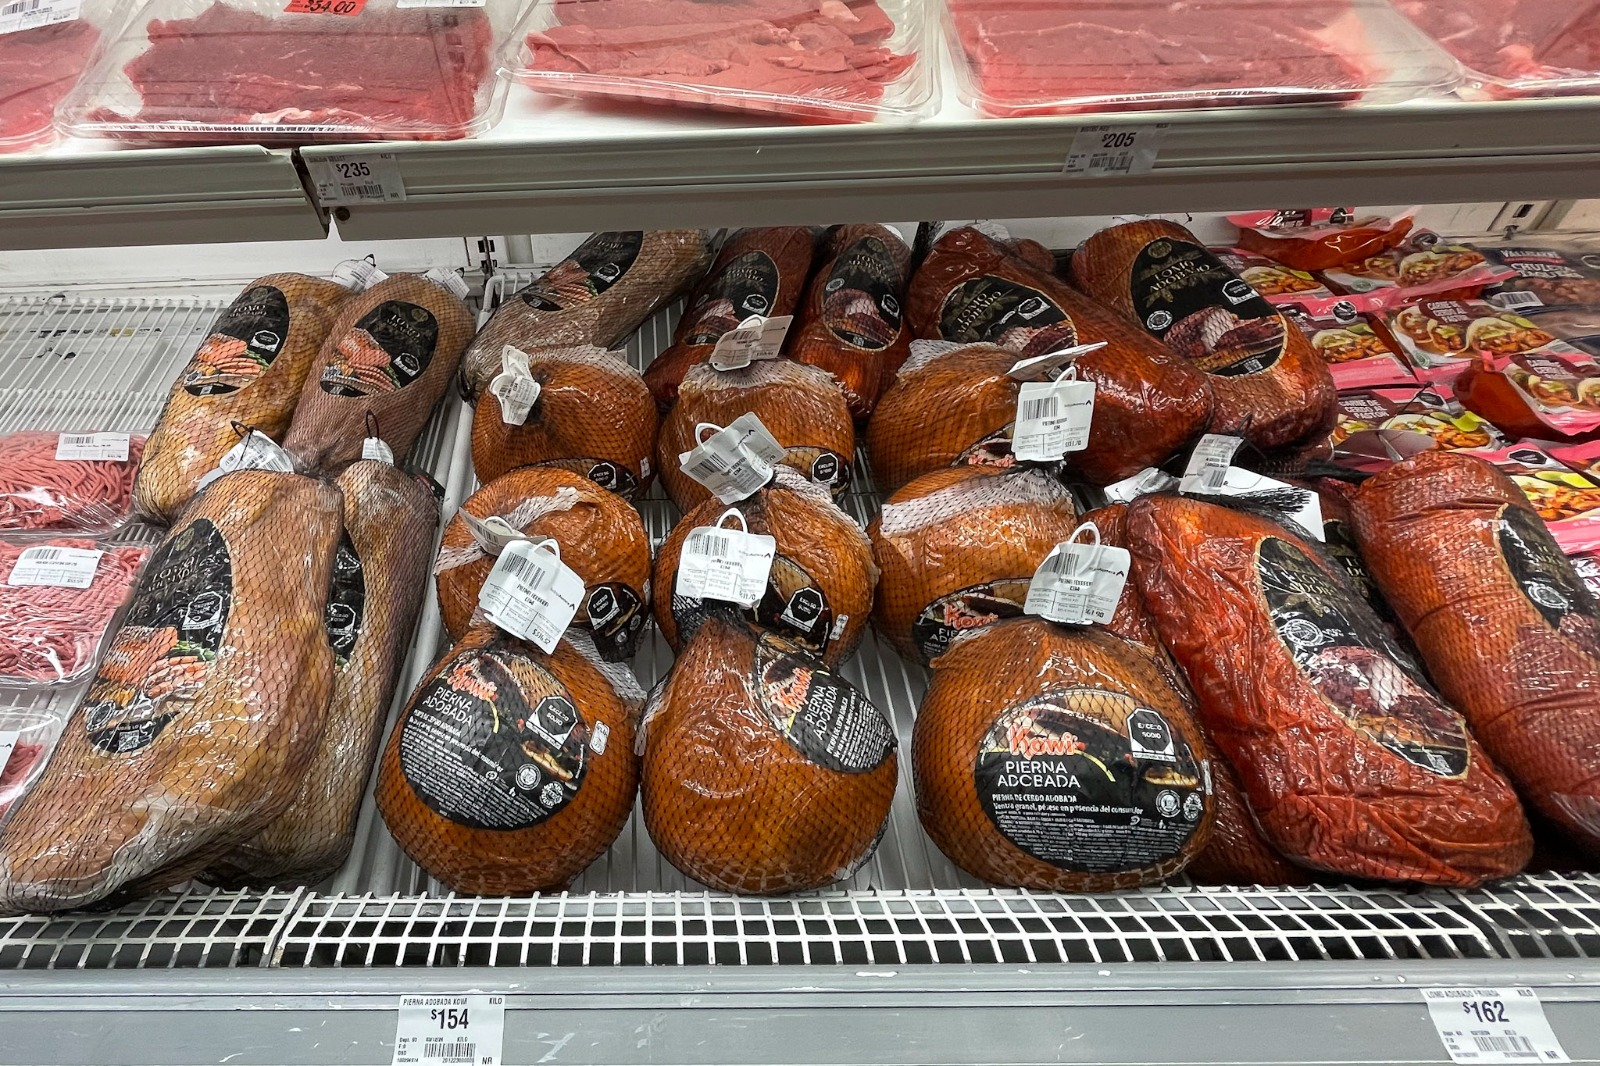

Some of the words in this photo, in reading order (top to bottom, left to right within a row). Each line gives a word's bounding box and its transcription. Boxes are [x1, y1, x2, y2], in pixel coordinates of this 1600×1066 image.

[1101, 132, 1136, 149] $205
[336, 162, 370, 179] $235
[1154, 260, 1195, 281] LOMO
[957, 293, 987, 323] LOMO
[1338, 399, 1366, 407] CARNE
[1353, 411, 1389, 419] PASTOR
[433, 686, 473, 712] PIERNA
[805, 685, 826, 725] PIERNA
[422, 695, 473, 726] ADOBADA
[813, 686, 838, 740] ADOBADA
[1009, 722, 1075, 761] Kowi
[1141, 731, 1162, 740] SODIO
[1005, 761, 1068, 774] PIERNA
[997, 774, 1081, 789] ADOBADA
[1022, 794, 1045, 802] CERDO
[1100, 805, 1110, 813] del
[1426, 990, 1445, 998] LOMO
[1445, 990, 1474, 998] ADOBADO
[1517, 989, 1533, 997] KILO
[403, 998, 424, 1006] PIERNA
[425, 998, 452, 1006] ADOBADA
[452, 997, 468, 1005] KOWI
[489, 997, 503, 1005] KILO
[1463, 1000, 1510, 1022] $162
[431, 1008, 469, 1030] $154
[481, 1057, 493, 1065] NR
[1544, 1050, 1561, 1060] NR
